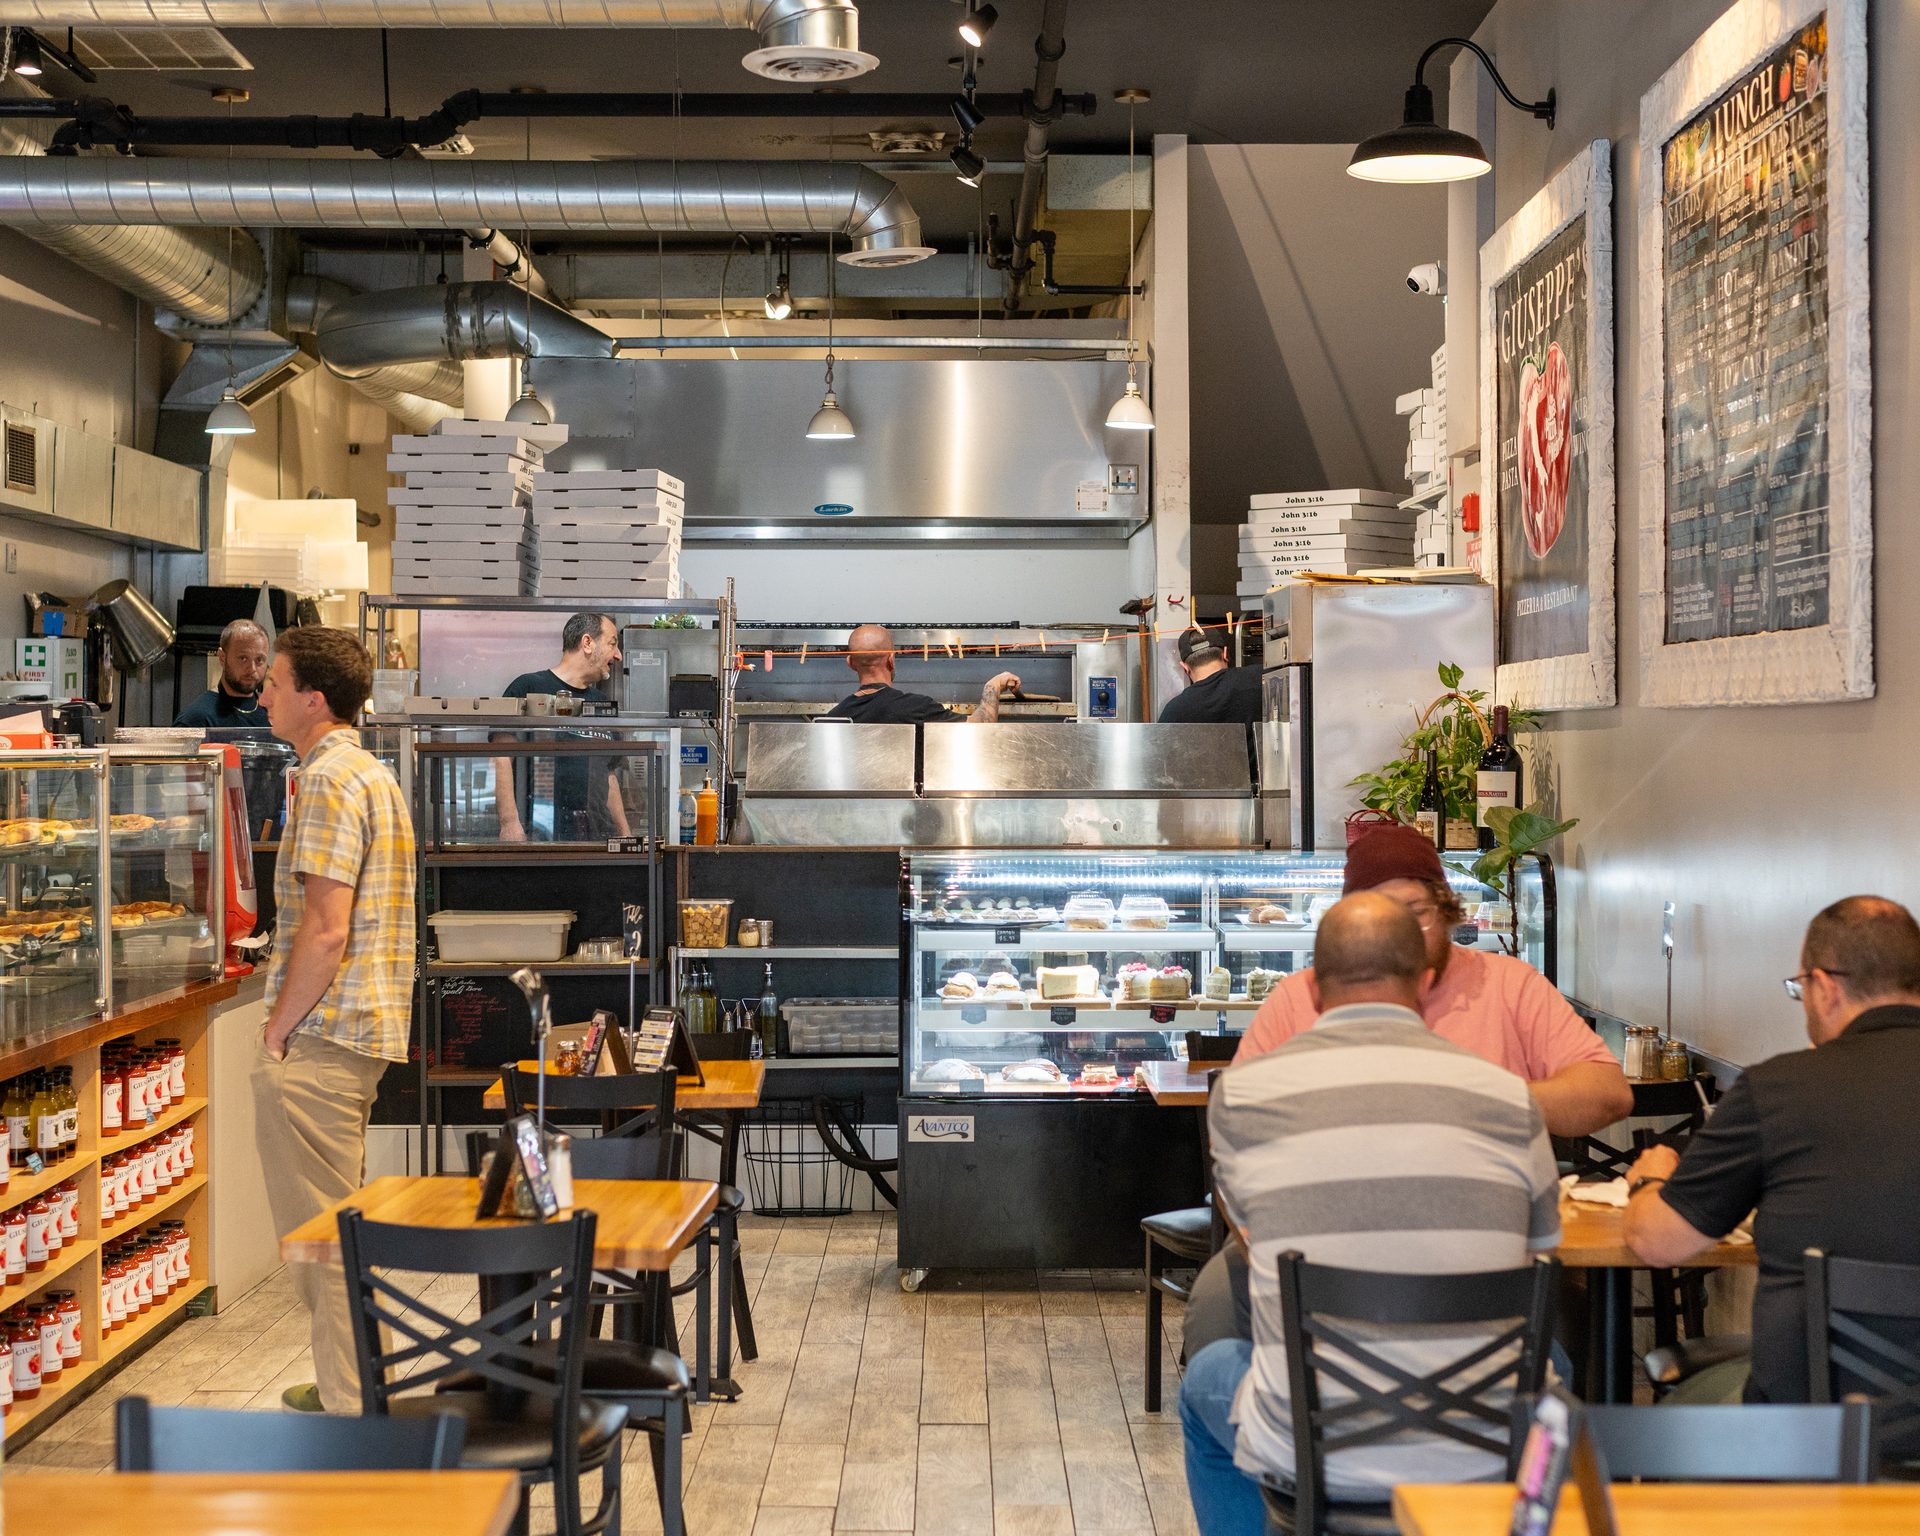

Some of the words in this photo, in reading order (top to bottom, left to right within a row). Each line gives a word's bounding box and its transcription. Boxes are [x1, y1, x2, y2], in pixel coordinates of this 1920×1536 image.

[1714, 63, 1774, 151] LUNCH
[1771, 114, 1805, 154] PASTA
[1668, 192, 1702, 231] SALADS
[1772, 229, 1818, 279] PANINI'S
[1717, 268, 1739, 297] HOT
[1502, 436, 1518, 462] PIZZA
[1502, 466, 1518, 492] PASTA
[1517, 596, 1540, 616] PIZZERIA
[1544, 585, 1578, 610] RESTAURANT
[914, 1119, 969, 1133] AVANTCO
